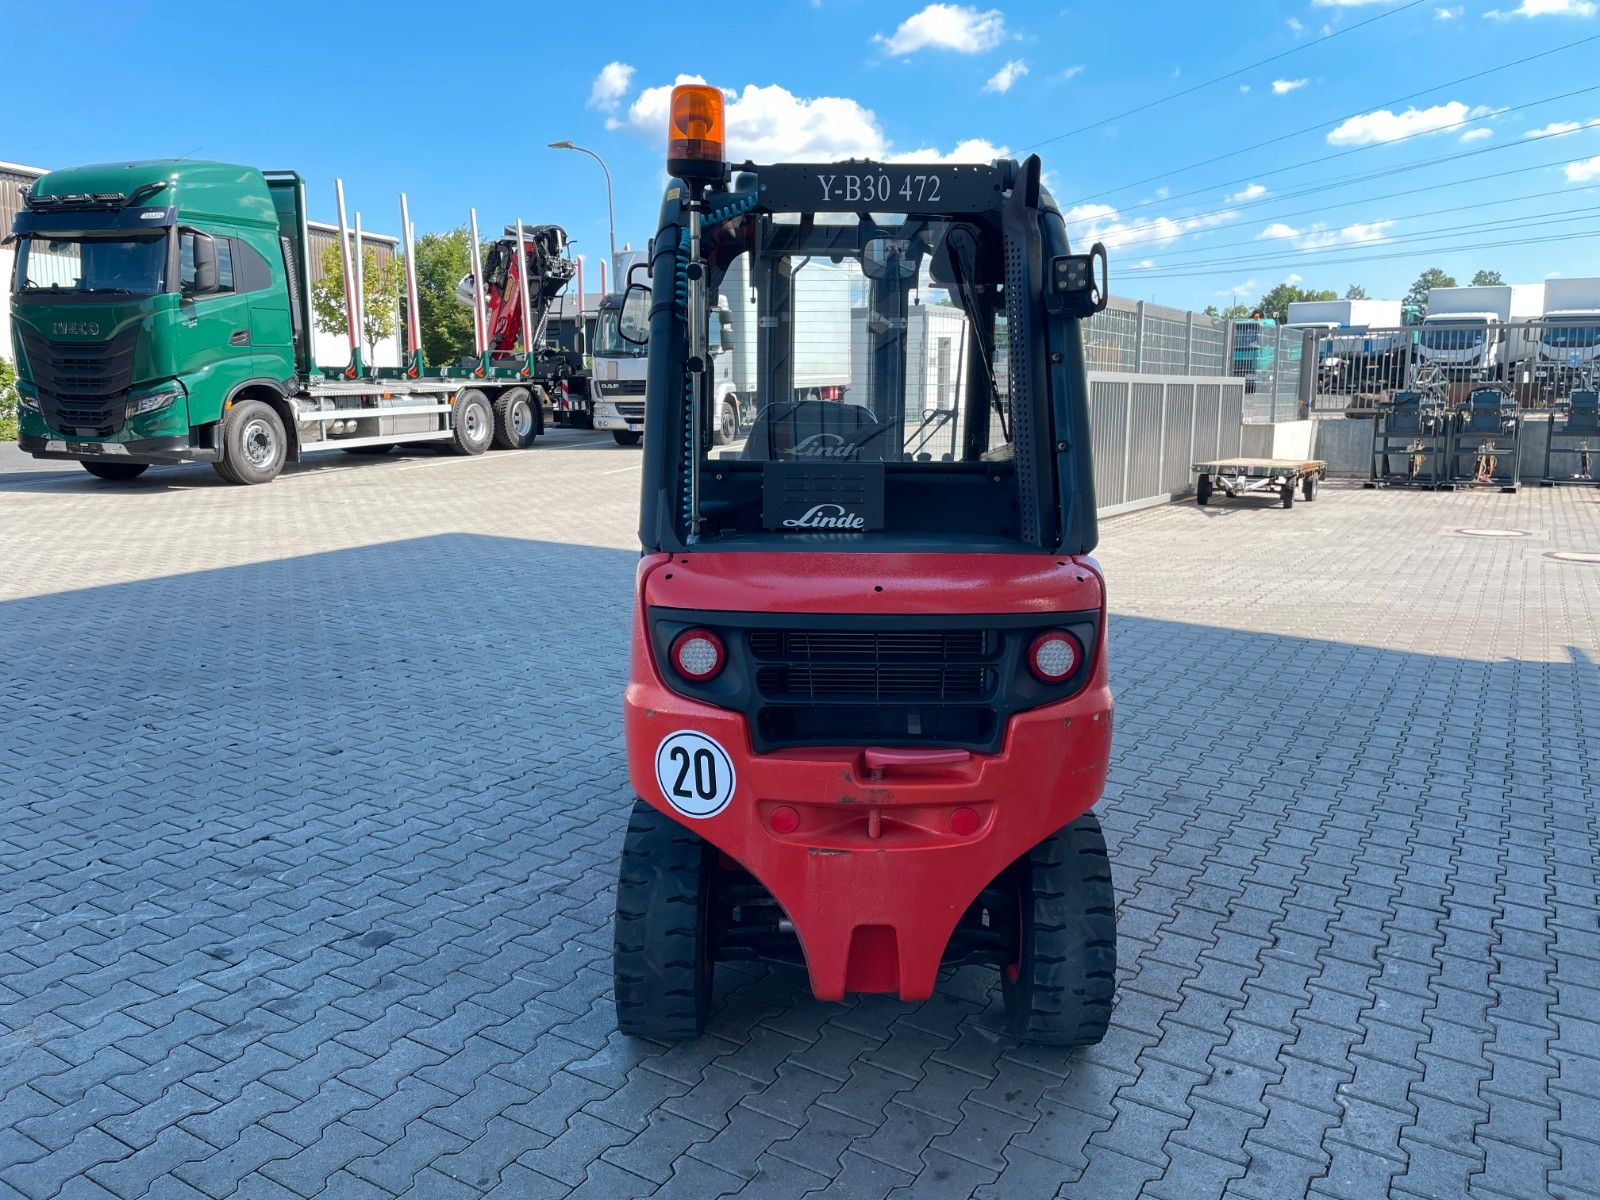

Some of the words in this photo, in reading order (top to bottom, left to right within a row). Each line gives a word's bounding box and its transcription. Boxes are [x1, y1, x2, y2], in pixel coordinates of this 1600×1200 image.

[816, 174, 891, 202] Y-B30
[898, 174, 941, 202] 472
[51, 321, 100, 336] IVECO
[782, 503, 864, 528] Linde
[670, 746, 717, 801] 20
